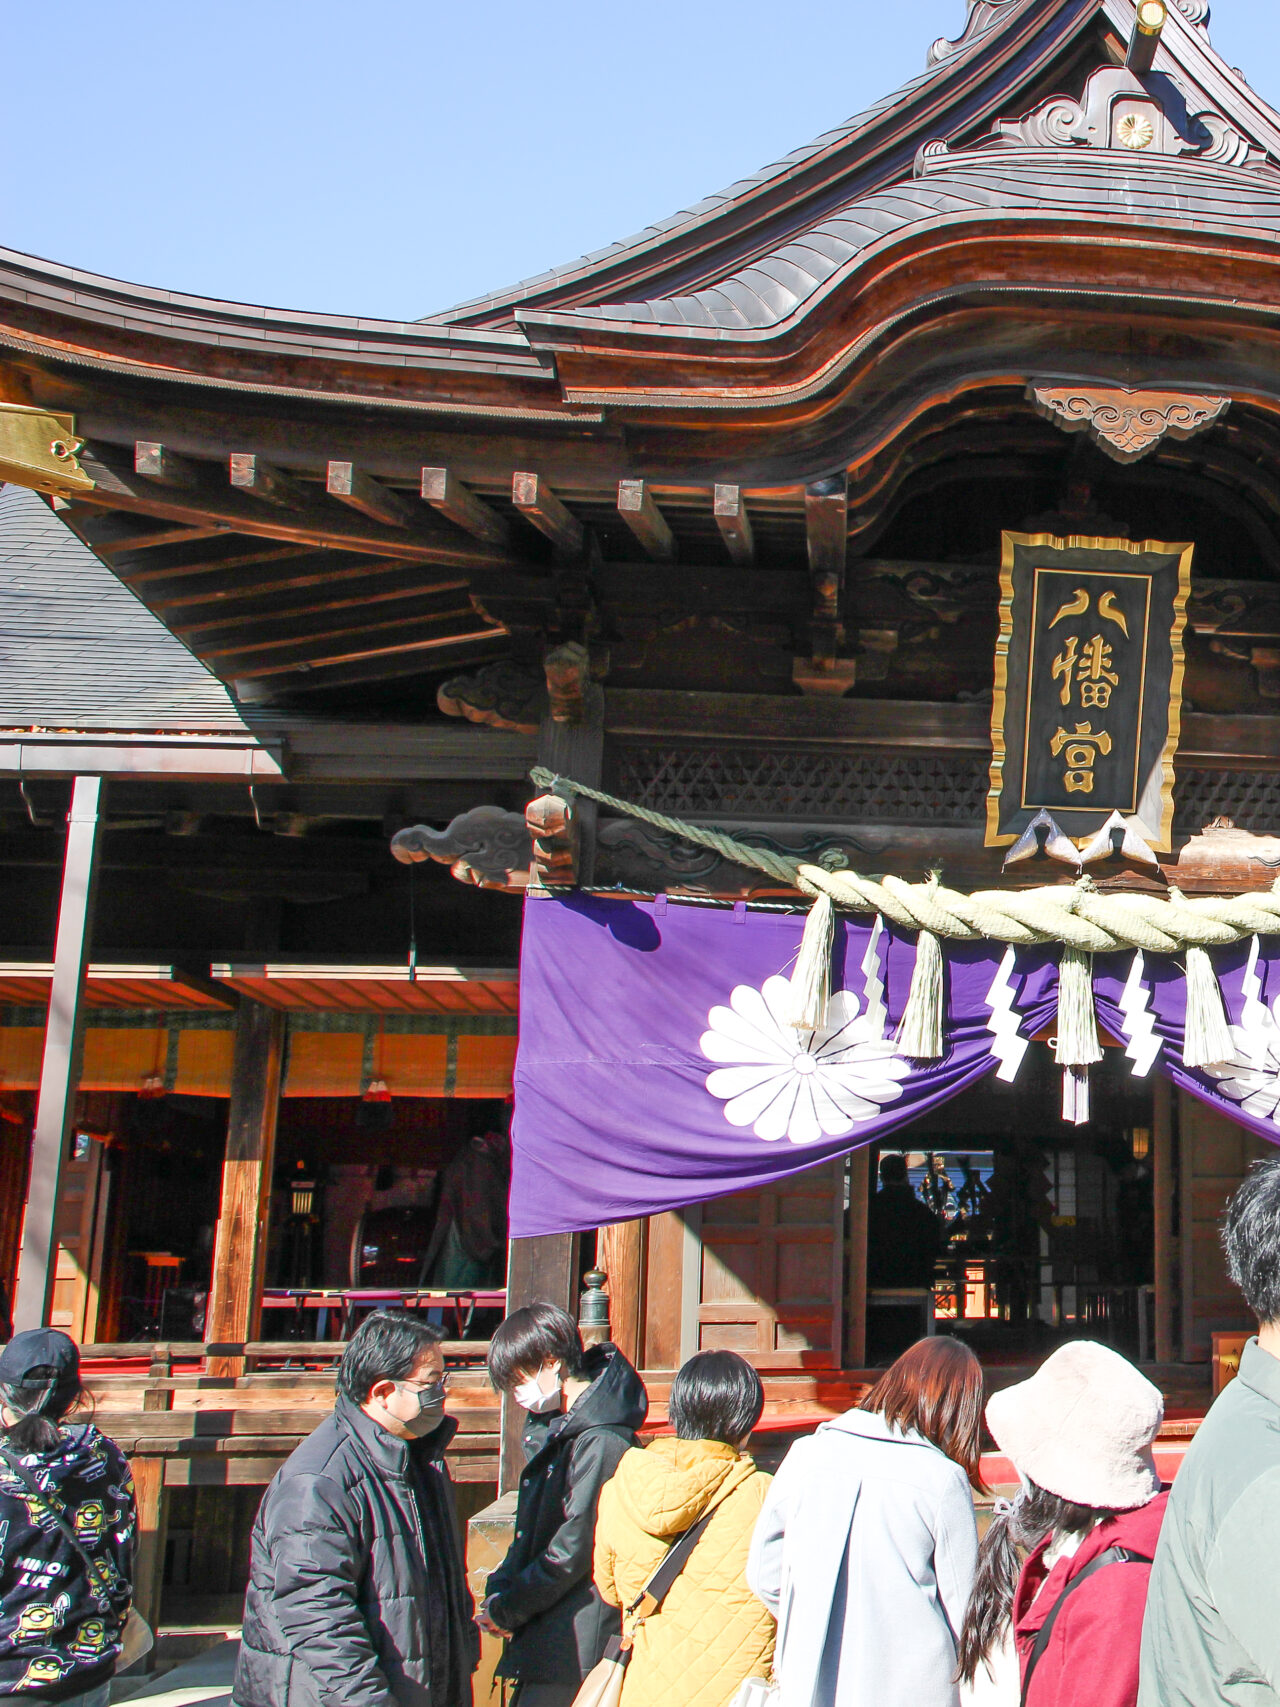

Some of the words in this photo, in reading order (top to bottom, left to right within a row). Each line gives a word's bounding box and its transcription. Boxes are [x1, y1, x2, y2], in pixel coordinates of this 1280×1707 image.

[1049, 587, 1130, 794] 八幡宮
[13, 1556, 71, 1577] MINION
[18, 1572, 54, 1589] LIFE
